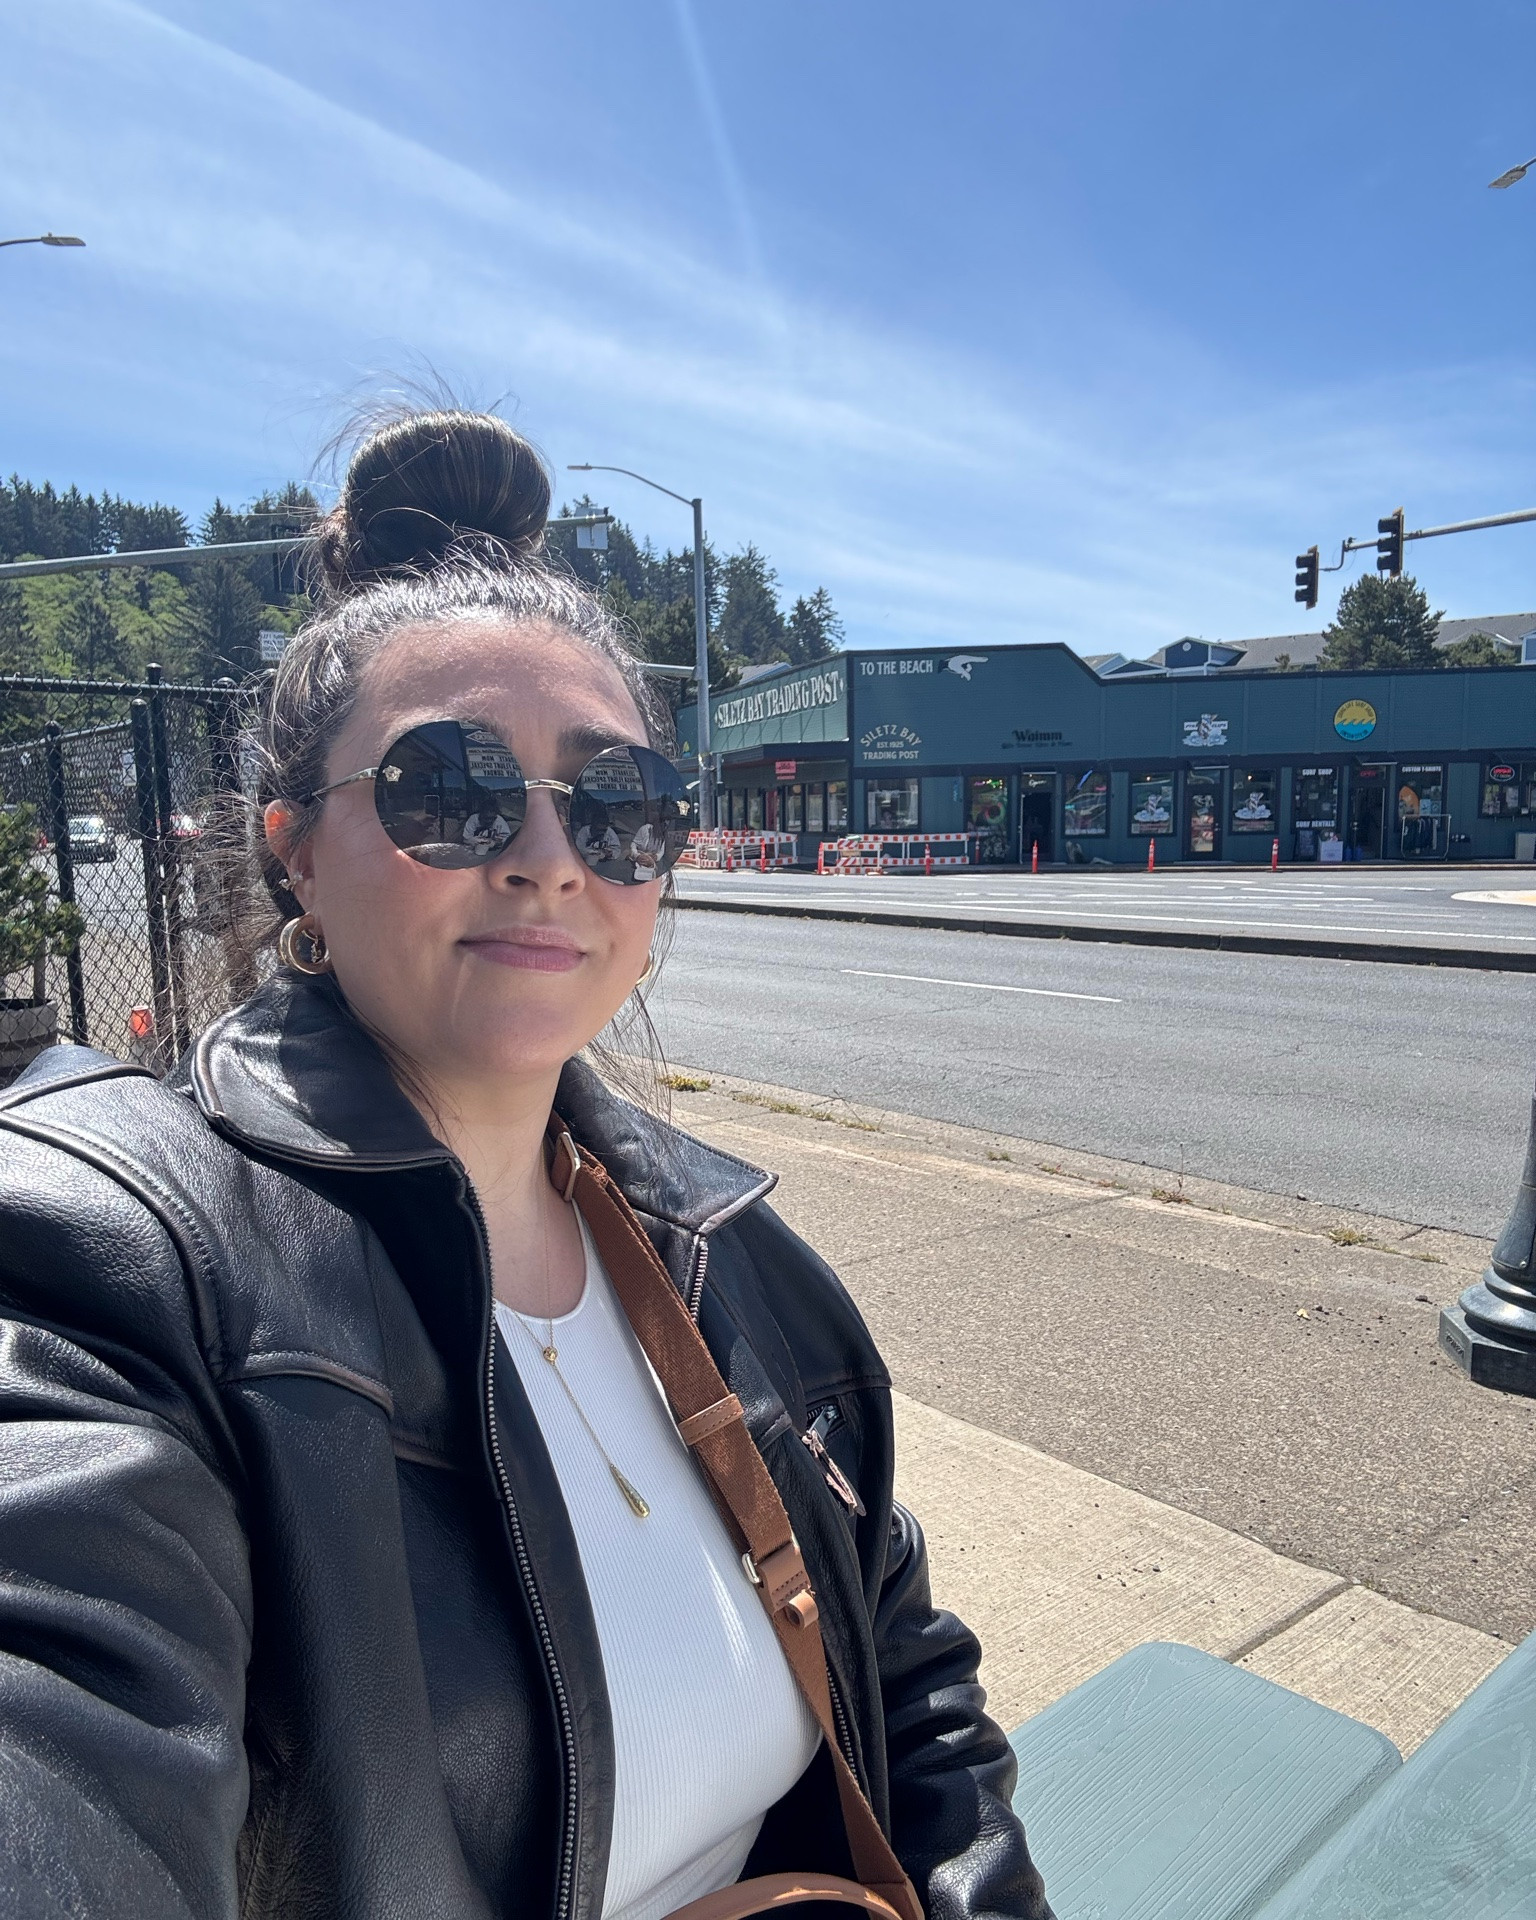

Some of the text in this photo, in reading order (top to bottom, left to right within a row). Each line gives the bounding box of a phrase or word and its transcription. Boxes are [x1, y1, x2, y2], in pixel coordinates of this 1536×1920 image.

[860, 660, 933, 675] TO THE BEACH
[717, 670, 839, 728] SILETZ BAY TRADING POST
[860, 724, 922, 747] SILETZ BAY
[863, 750, 919, 760] TRADING POST
